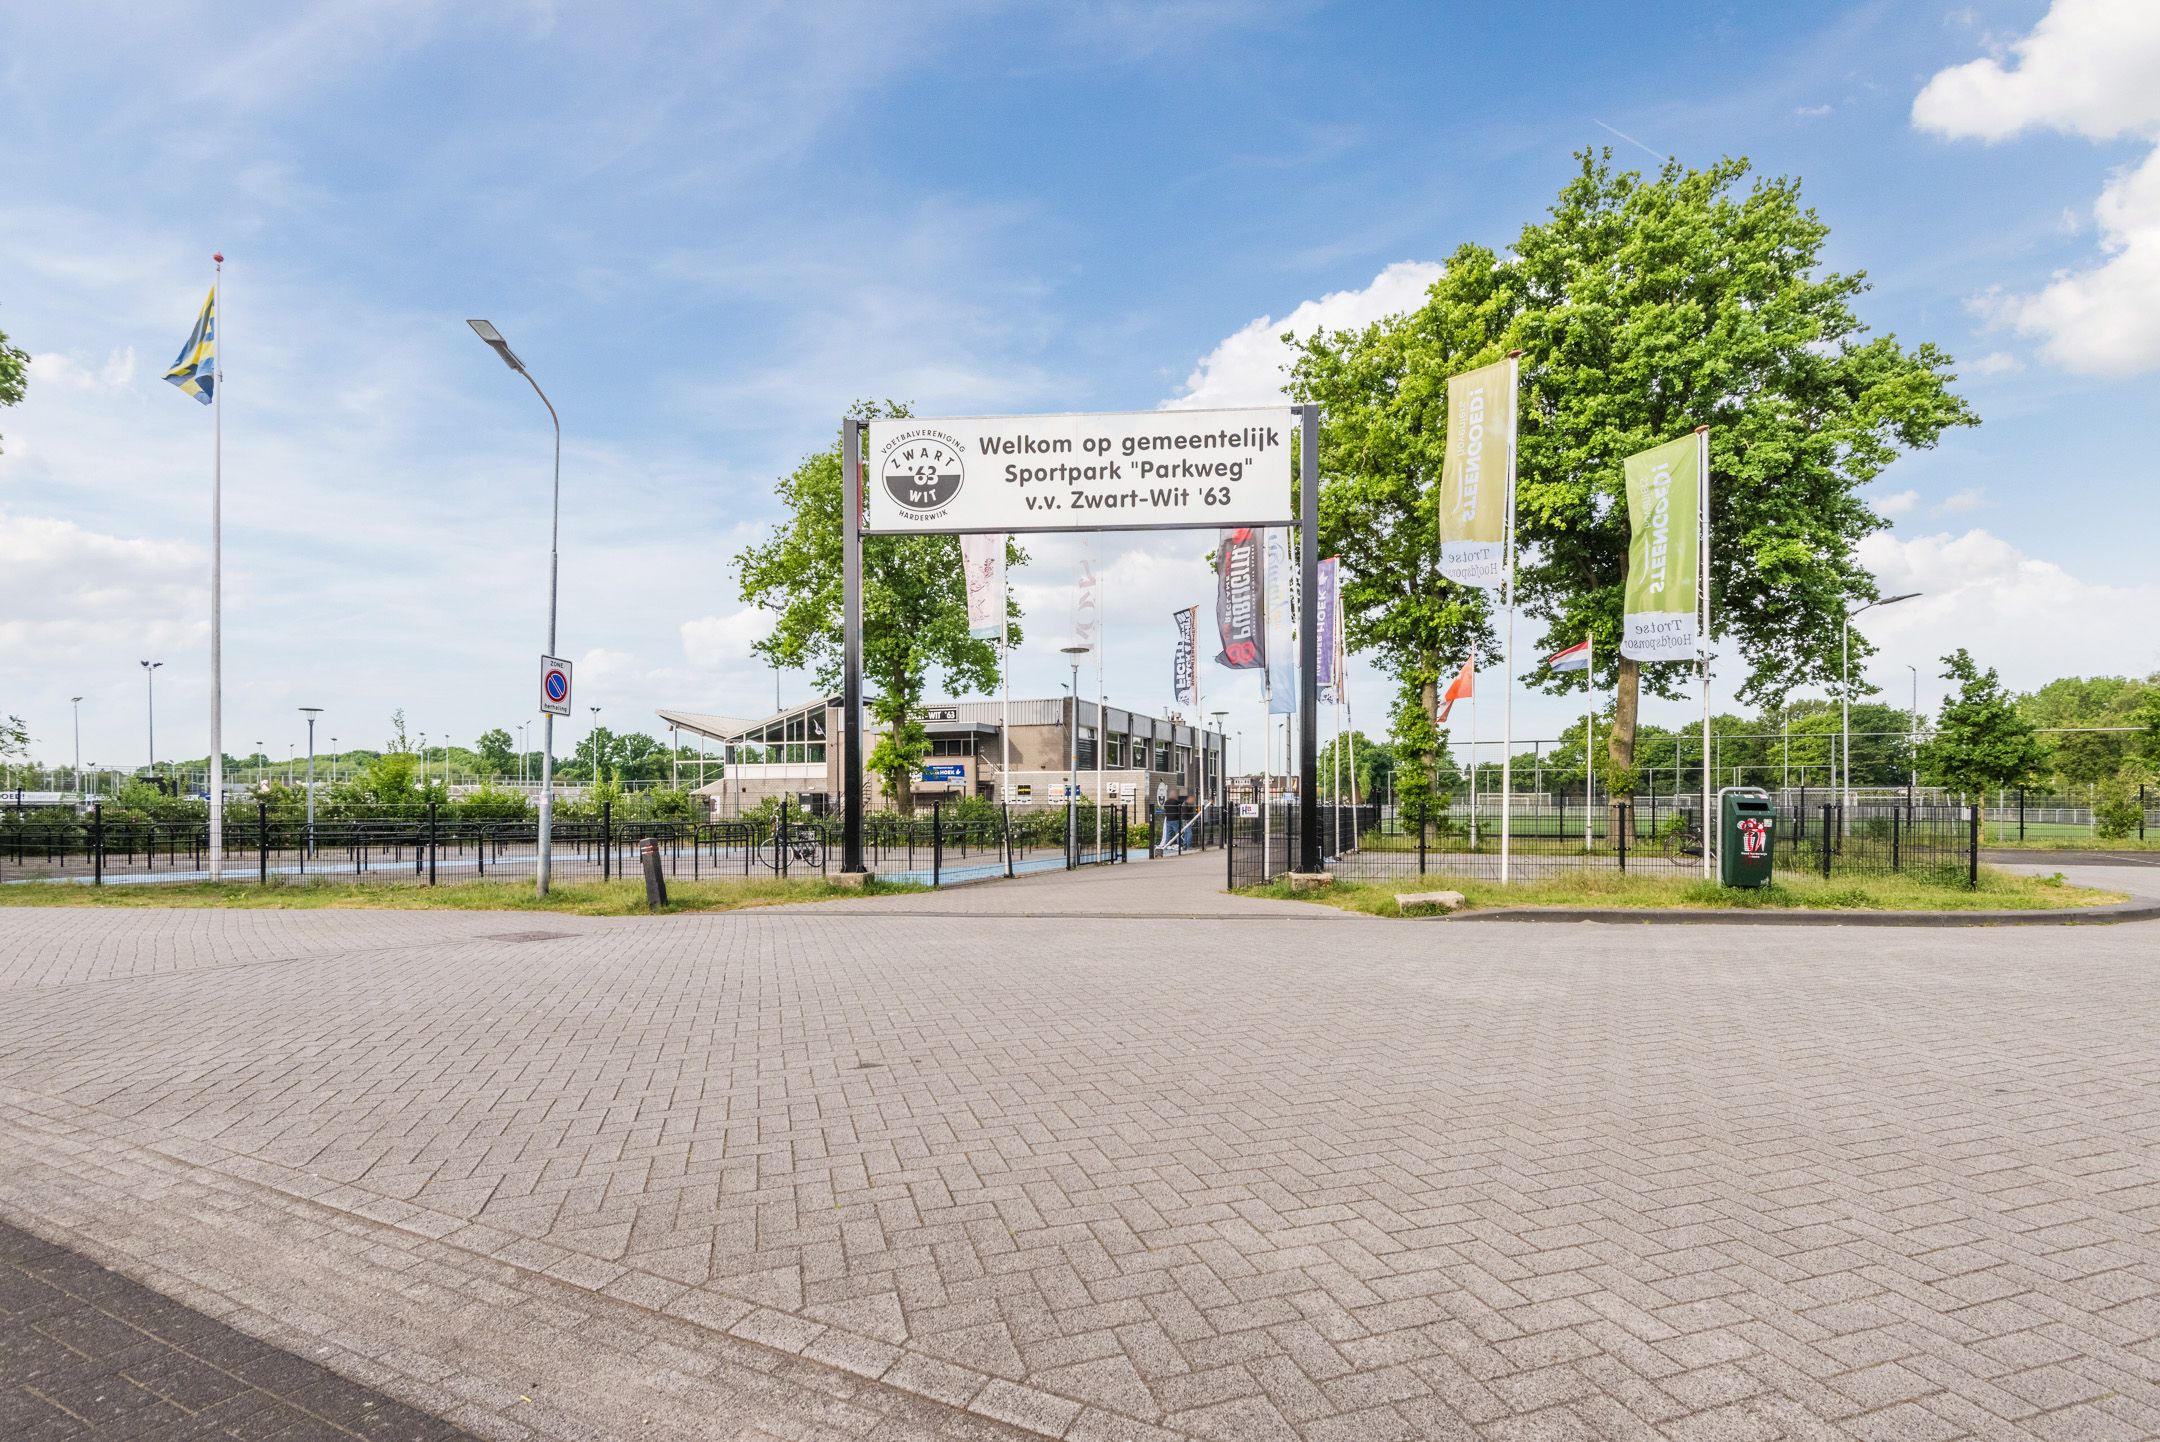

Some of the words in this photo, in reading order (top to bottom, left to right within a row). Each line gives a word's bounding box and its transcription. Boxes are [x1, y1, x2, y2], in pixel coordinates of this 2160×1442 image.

[881, 429, 966, 454] VOETBALVERENIGING
[979, 435, 1072, 456] Welkom
[1082, 437, 1112, 457] op
[1121, 427, 1280, 456] gemeentelijk
[891, 448, 955, 469] ZWART
[1004, 460, 1122, 487] Sportpark
[1130, 457, 1253, 482] "Parkweg"
[909, 489, 937, 503] WIT
[1025, 495, 1061, 511] v.v.
[1070, 487, 1190, 509] Zwart-Wit
[1199, 486, 1232, 506] '63
[899, 509, 948, 522] HARDERWIJK
[550, 660, 564, 669] ZONE
